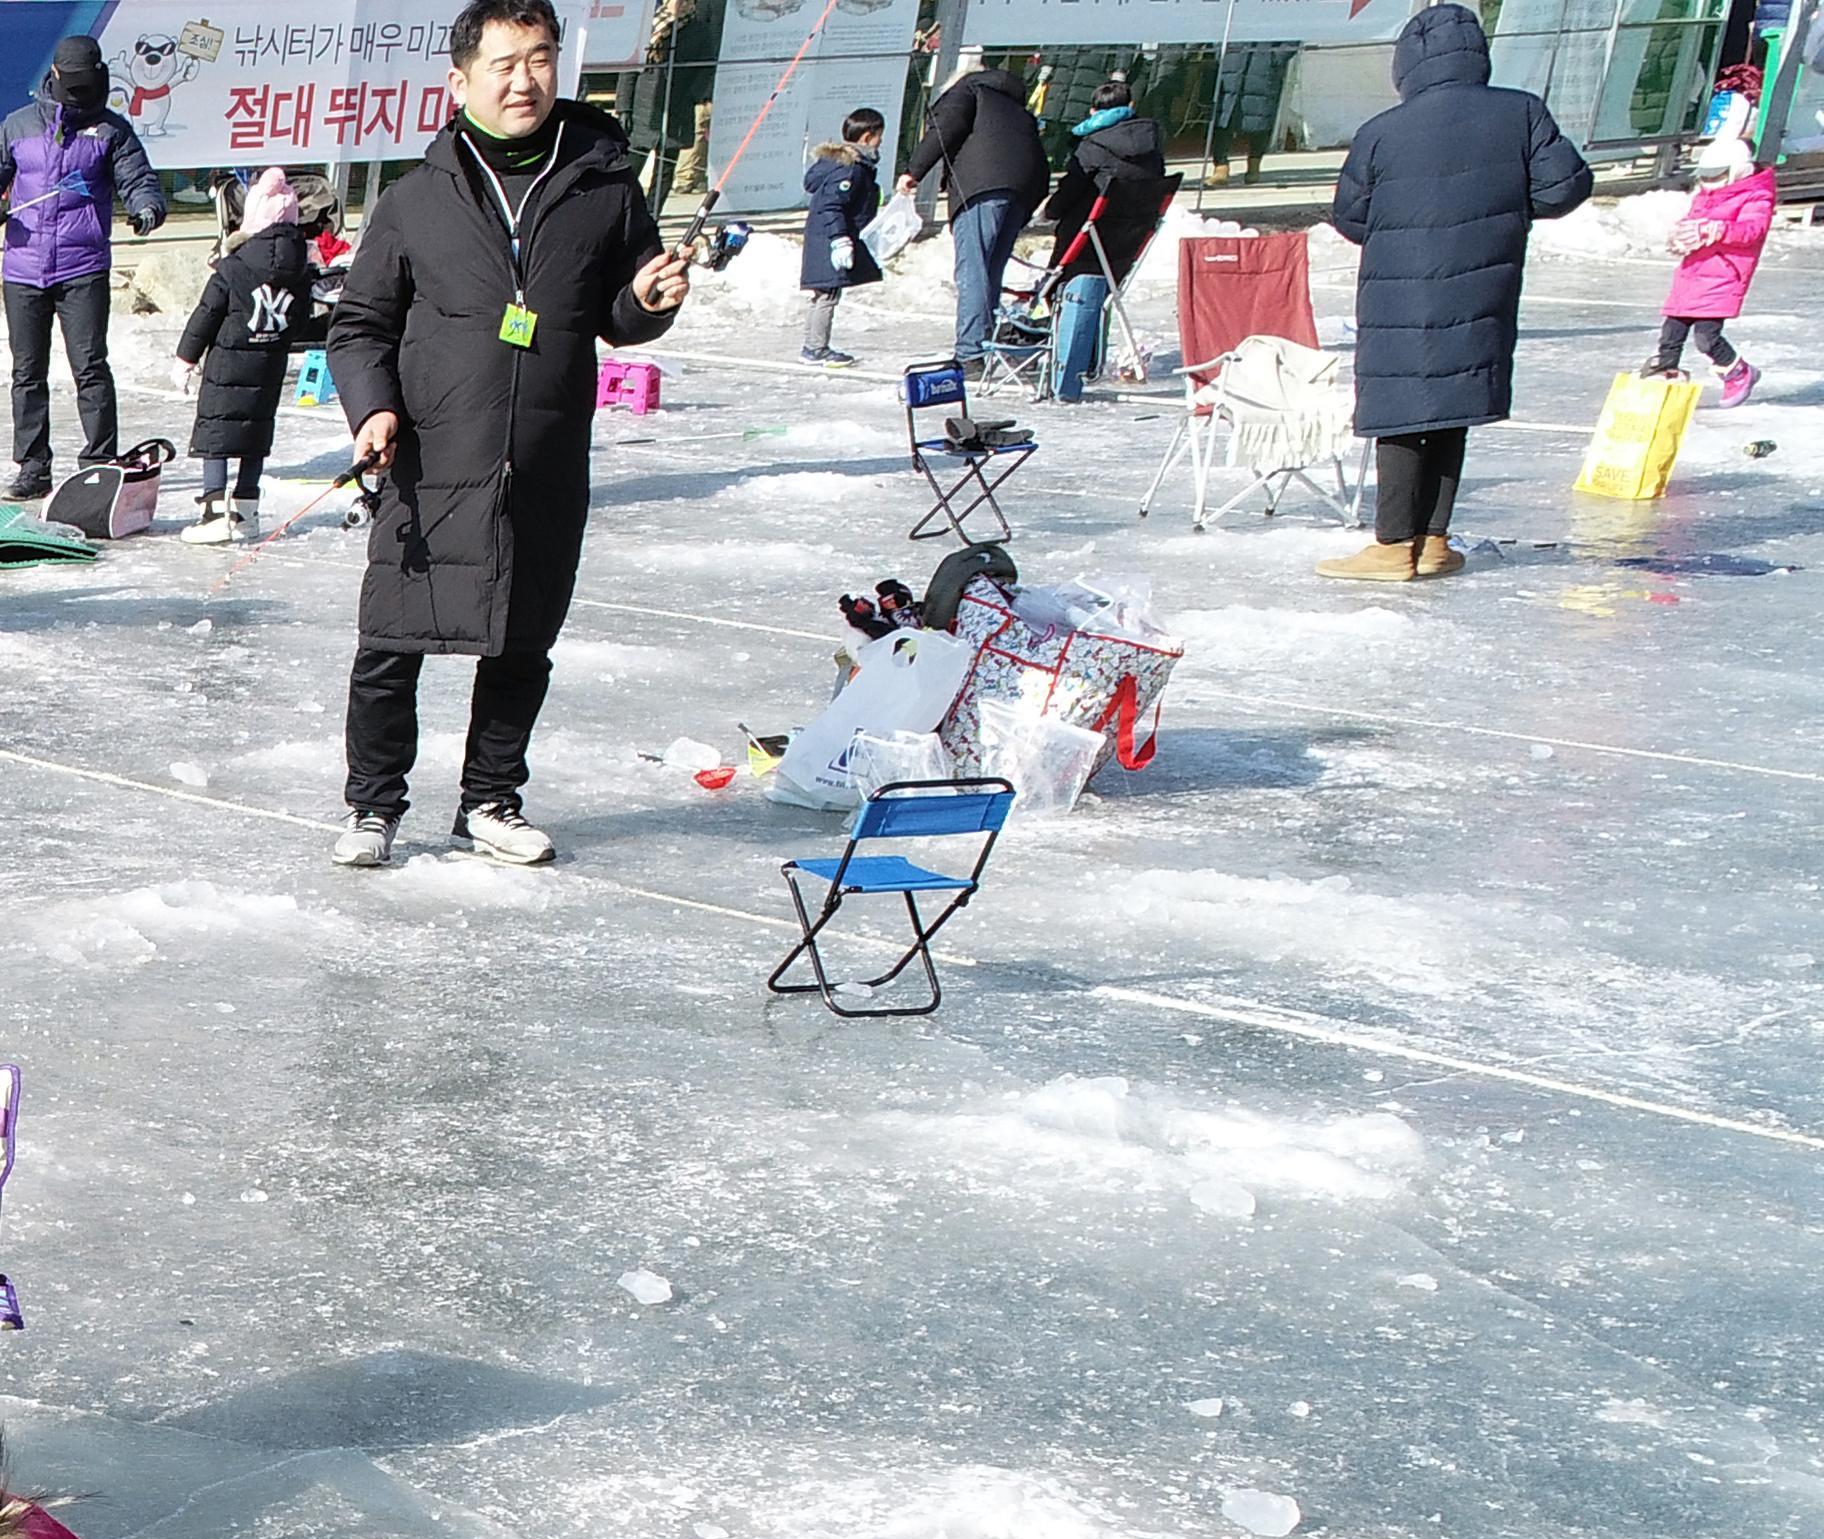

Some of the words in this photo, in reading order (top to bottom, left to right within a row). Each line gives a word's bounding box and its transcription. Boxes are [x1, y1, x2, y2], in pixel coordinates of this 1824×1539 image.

[233, 22, 345, 67] 낚시터가
[350, 22, 402, 63] 매우
[224, 83, 315, 149] 절대
[323, 80, 409, 147] 뛰지
[247, 283, 295, 332] NY
